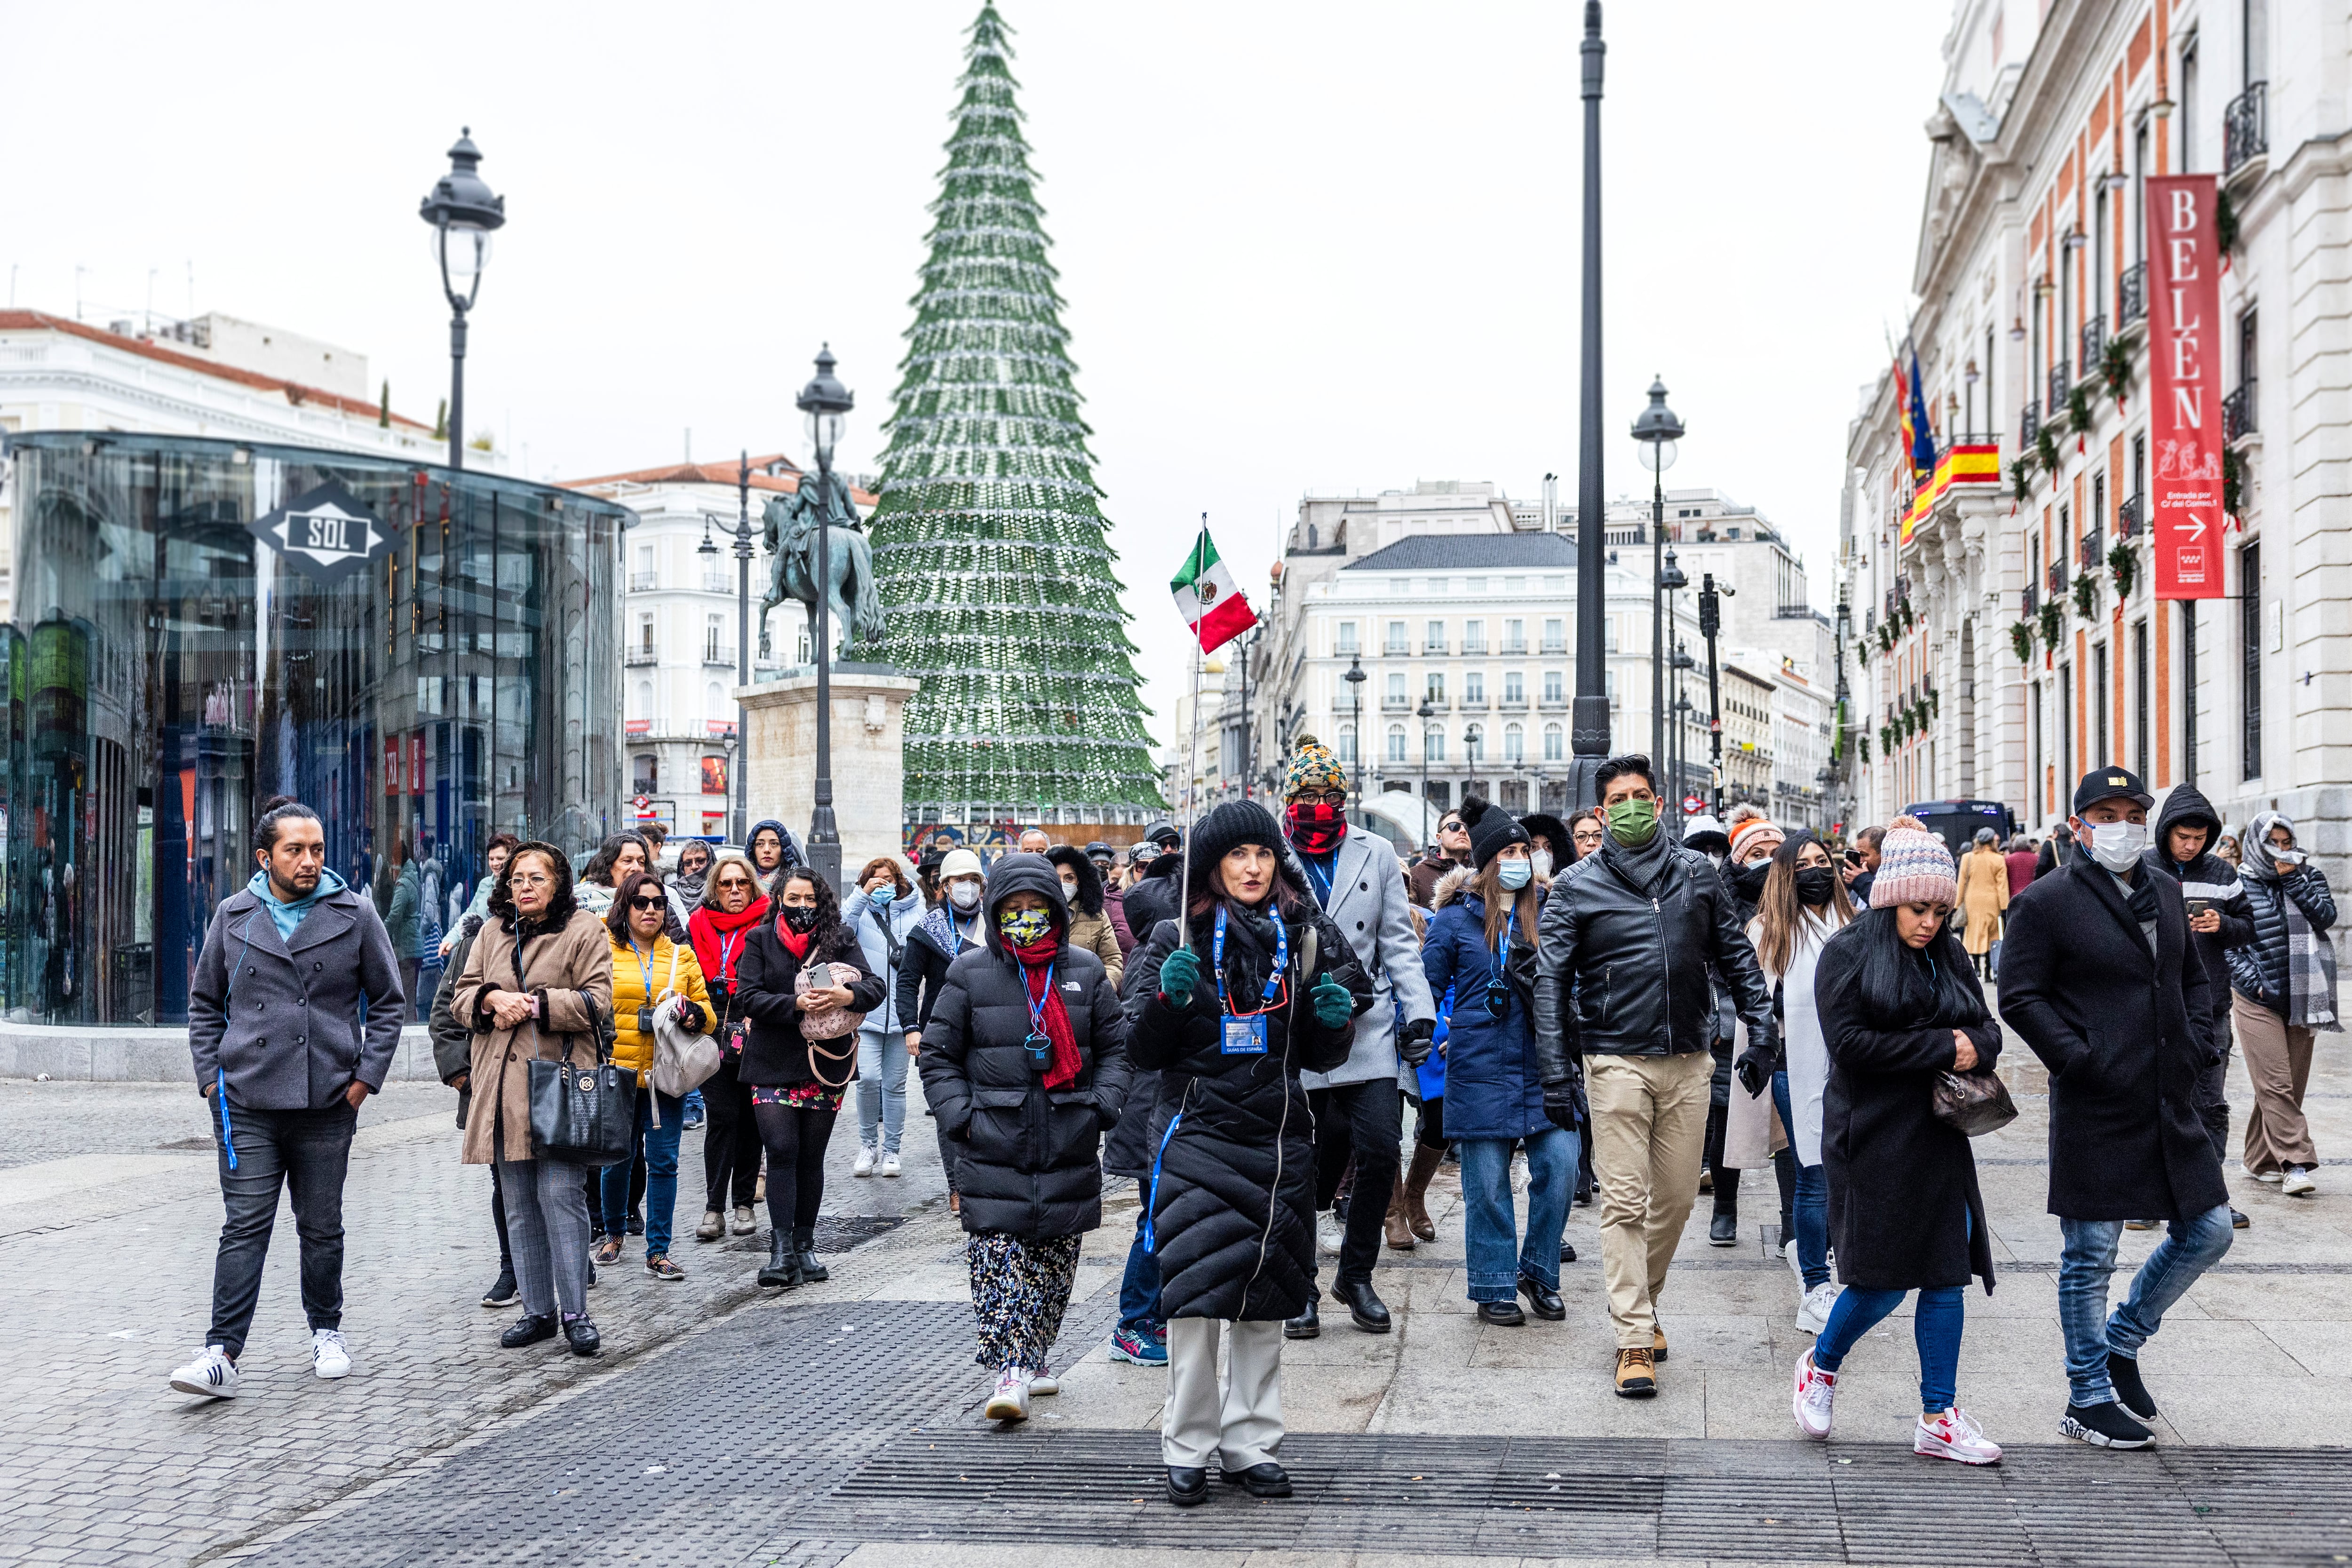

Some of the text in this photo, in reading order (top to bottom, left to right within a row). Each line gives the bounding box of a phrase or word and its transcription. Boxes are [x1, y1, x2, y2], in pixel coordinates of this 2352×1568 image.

[2169, 189, 2204, 430] BELÉN
[308, 517, 350, 549] SOL
[1273, 917, 1285, 939] CEFAPIT
